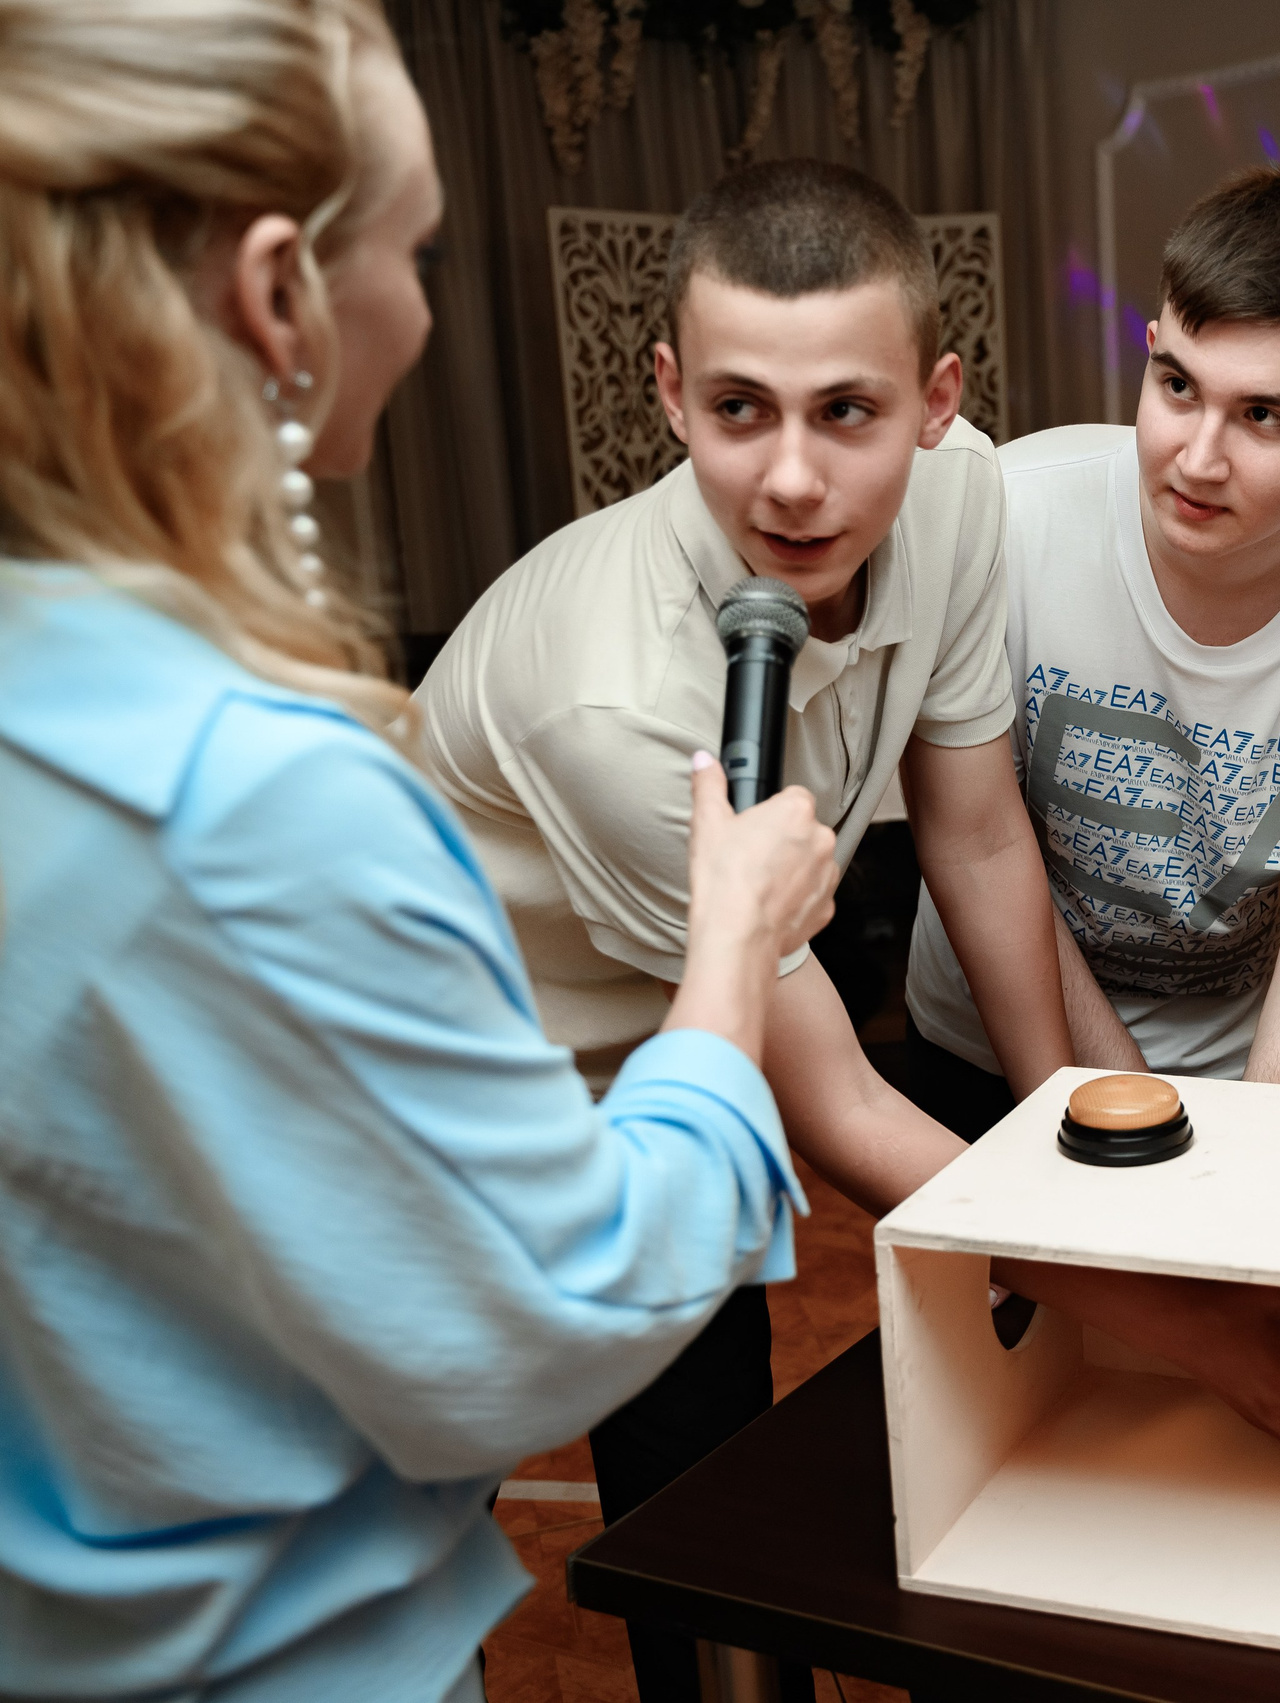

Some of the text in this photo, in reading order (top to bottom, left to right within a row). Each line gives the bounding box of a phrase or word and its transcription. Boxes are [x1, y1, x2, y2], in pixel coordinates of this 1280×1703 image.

[1066, 683, 1108, 705] EA7
[1110, 684, 1167, 715] EA7
[1192, 722, 1255, 754] EA7
[1094, 748, 1155, 778] EA7
[1150, 767, 1186, 790] EA7
[1186, 776, 1239, 816] EA7
[1234, 803, 1268, 821] EA7
[1179, 800, 1228, 840] EA7
[1073, 832, 1130, 865] EA7
[1126, 859, 1165, 878] EA7
[1165, 856, 1217, 889] EA7
[1174, 829, 1224, 867] EA7
[1114, 907, 1152, 924] EA7
[1163, 887, 1197, 909] EA
